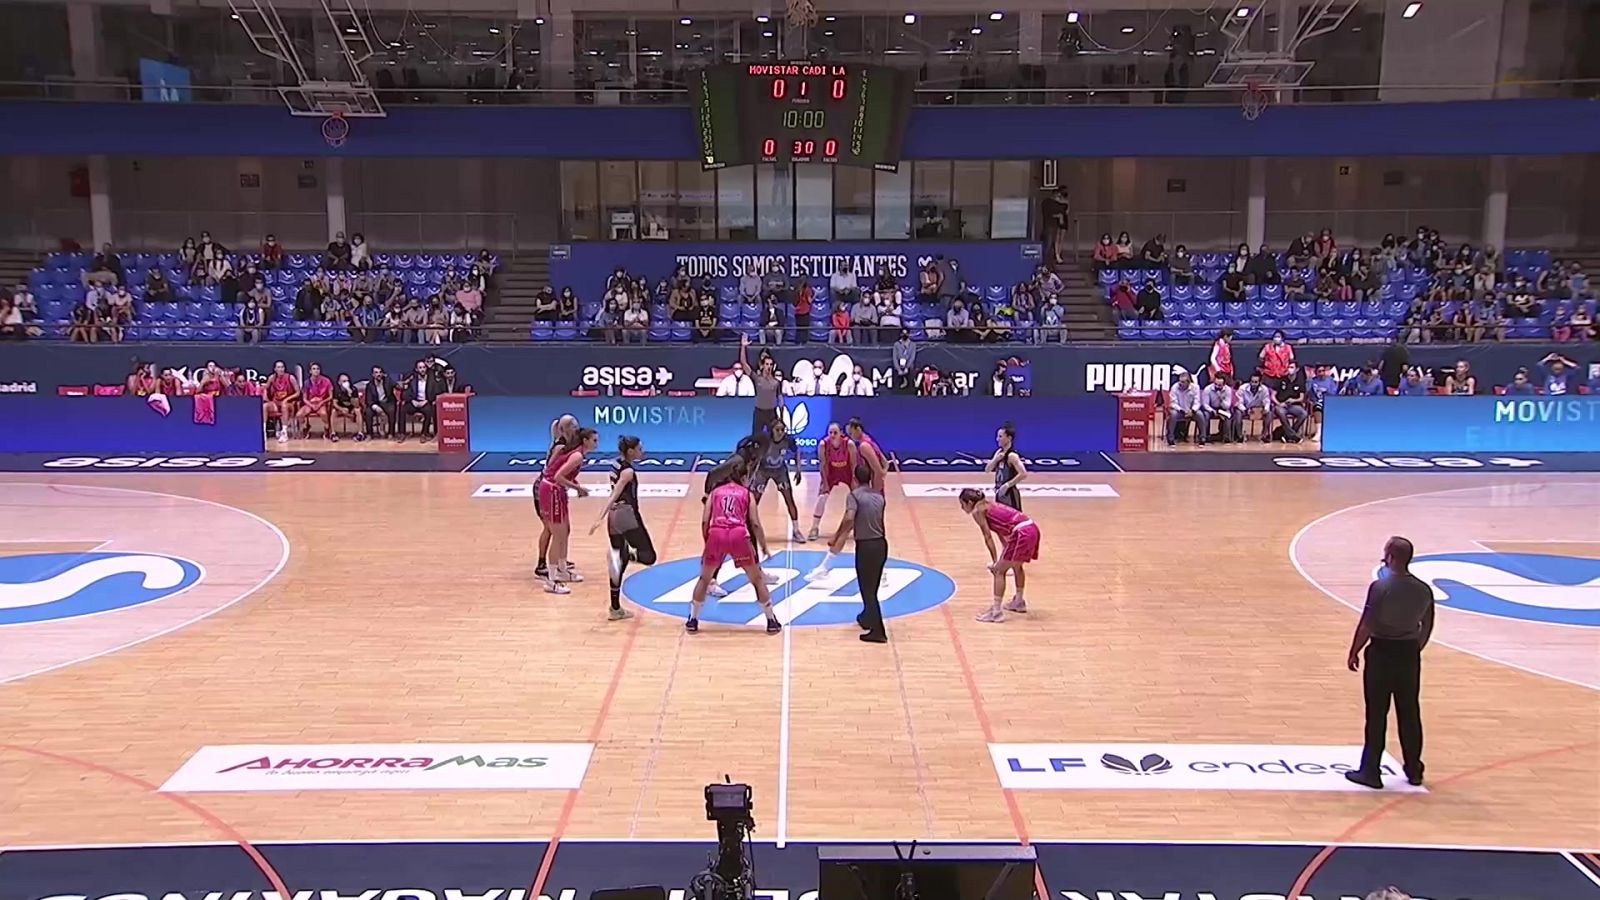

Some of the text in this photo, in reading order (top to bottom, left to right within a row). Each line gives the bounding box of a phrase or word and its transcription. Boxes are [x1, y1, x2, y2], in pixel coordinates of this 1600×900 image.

[749, 66, 845, 76] MOVISTAR CADI LA
[774, 79, 784, 98] 0
[801, 82, 806, 96] 1
[833, 79, 844, 98] 0
[783, 110, 824, 128] 10:00
[764, 139, 774, 155] 0
[825, 140, 836, 156] 0
[677, 256, 727, 277] TODOS
[583, 366, 653, 386] asisa
[1086, 364, 1170, 391] PUMA
[595, 406, 705, 424] MOVISTAR
[43, 457, 259, 468] asisa
[1273, 457, 1484, 468] asisa
[1007, 757, 1087, 772] LF
